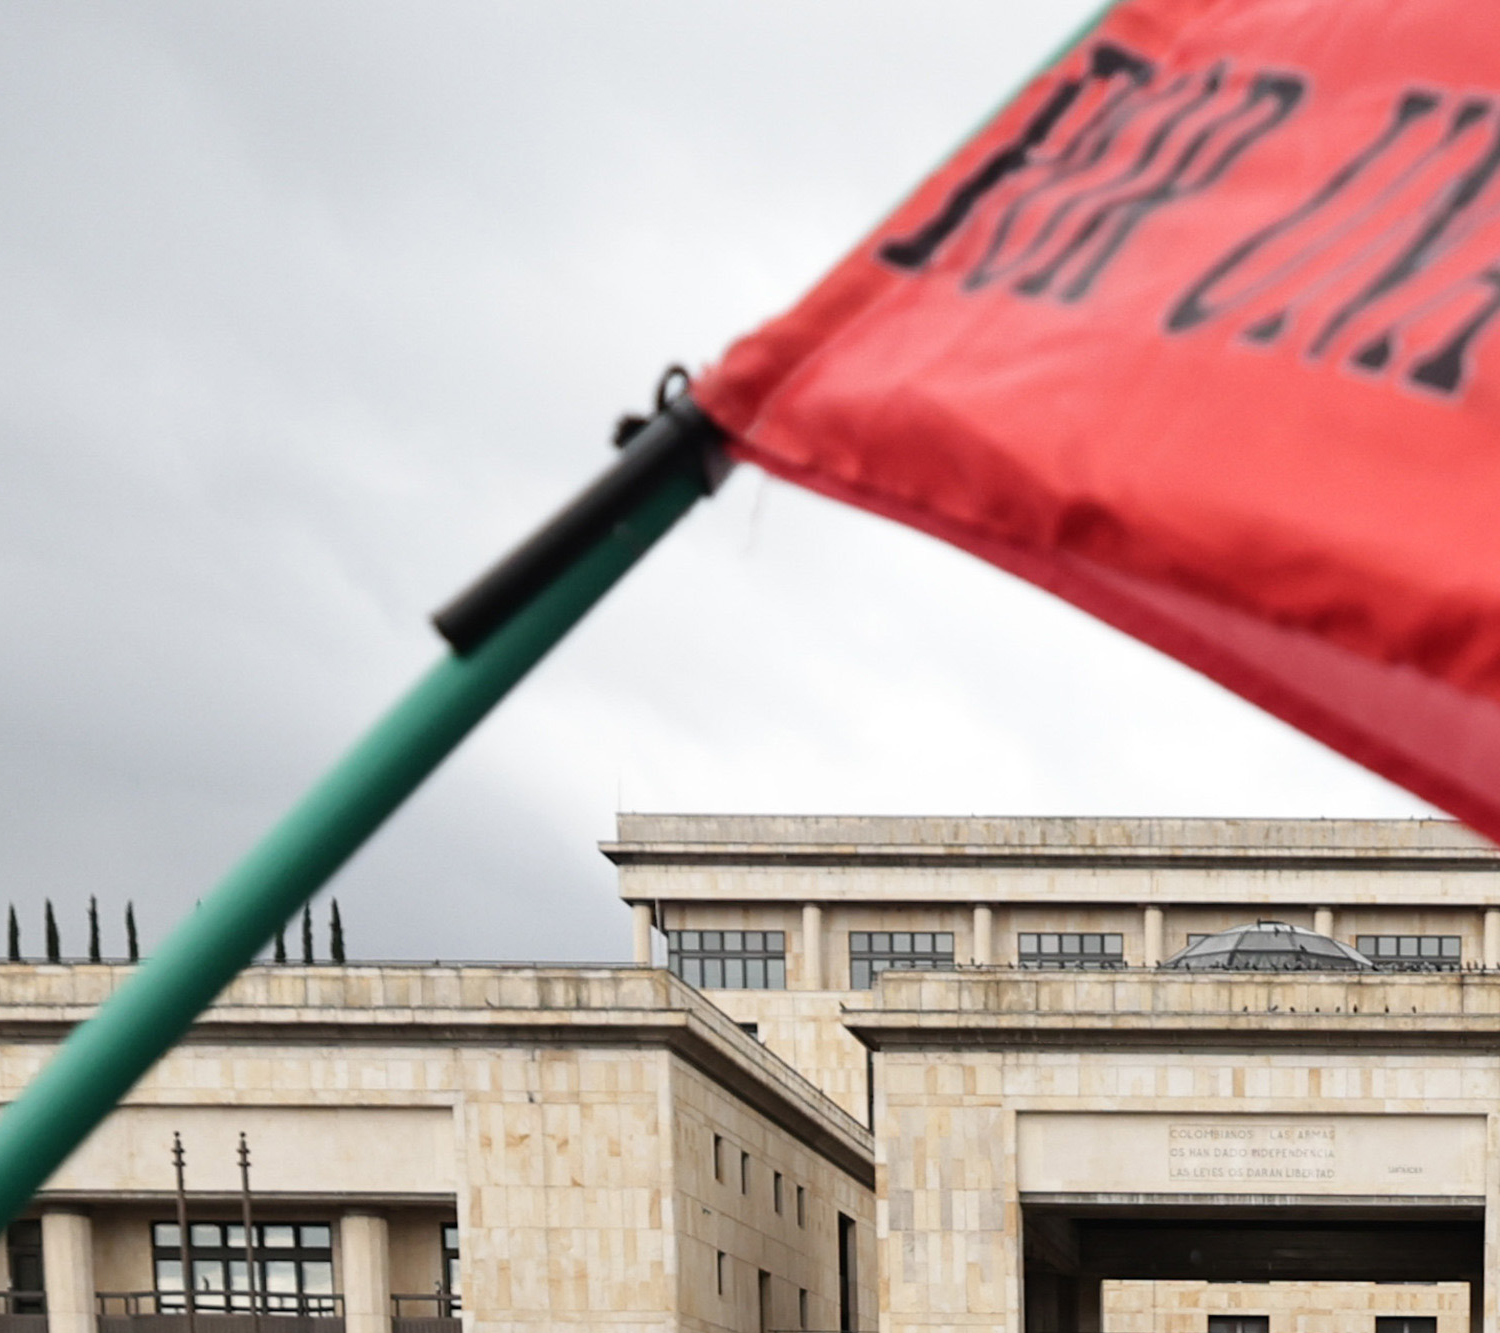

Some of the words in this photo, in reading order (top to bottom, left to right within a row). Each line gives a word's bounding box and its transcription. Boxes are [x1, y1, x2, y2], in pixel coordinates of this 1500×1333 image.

[1169, 1129, 1254, 1140] COLOMBIANOS
[1269, 1129, 1291, 1140] LAS
[1298, 1129, 1335, 1140] ARMAS
[1169, 1148, 1185, 1158] OS
[1189, 1148, 1210, 1158] HAN
[1214, 1148, 1248, 1158] DADO
[1251, 1148, 1335, 1158] INDEPENDENCIA
[1169, 1167, 1190, 1178] LAS
[1194, 1167, 1224, 1178] LEYES
[1228, 1167, 1243, 1178] OS
[1286, 1167, 1335, 1178] LIBERTAD
